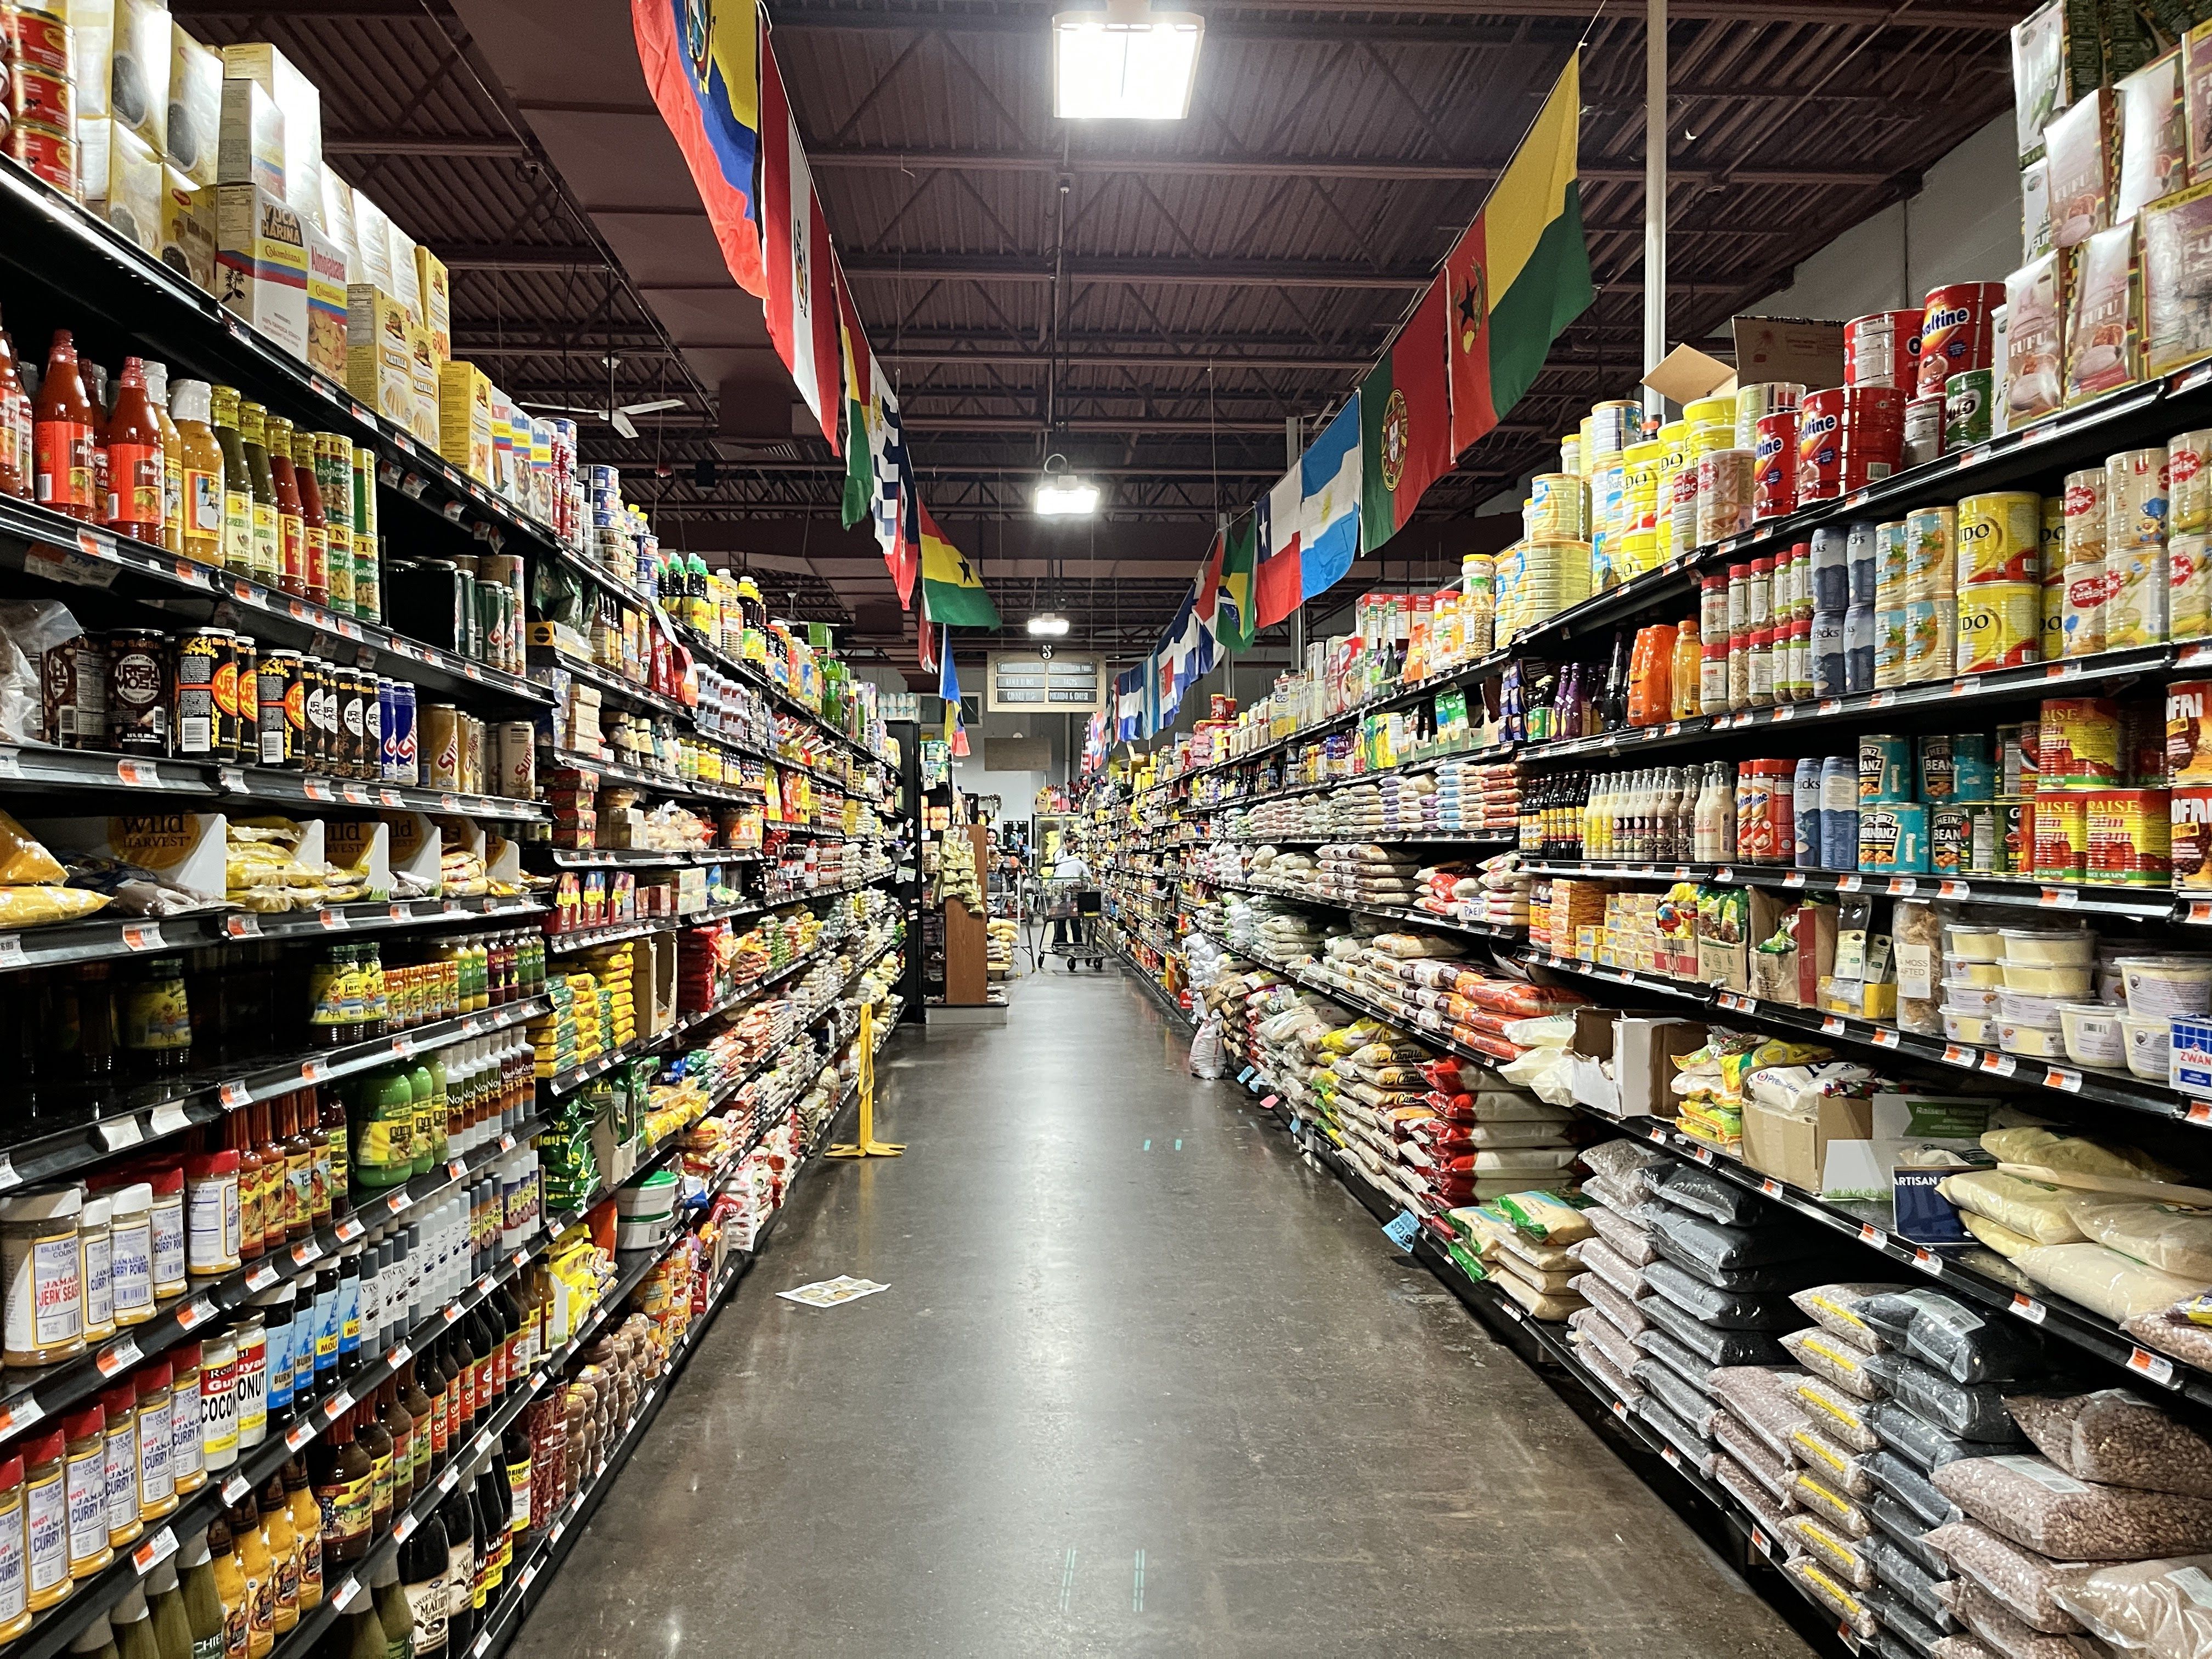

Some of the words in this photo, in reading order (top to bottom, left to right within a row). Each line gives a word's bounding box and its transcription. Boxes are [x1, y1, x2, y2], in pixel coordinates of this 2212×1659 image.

[262, 202, 297, 228] YUCA
[262, 219, 300, 244] HARINA
[2010, 330, 2048, 357] FUFU
[118, 664, 158, 677] IRISH
[115, 675, 161, 690] MOSS
[1905, 959, 1928, 967] MOSS
[1390, 1049, 1422, 1062] Canilla
[39, 1289, 61, 1307] JERK
[171, 1414, 186, 1426] HOT
[143, 1436, 159, 1449] HOT
[172, 1429, 195, 1447] CURRY
[144, 1449, 167, 1470] CURRY
[104, 1462, 119, 1474] HOT
[105, 1475, 129, 1497] CURRY
[70, 1488, 86, 1501] HOT
[72, 1500, 99, 1523] CURRY
[32, 1515, 49, 1529] HOT
[33, 1530, 60, 1553] CURRY
